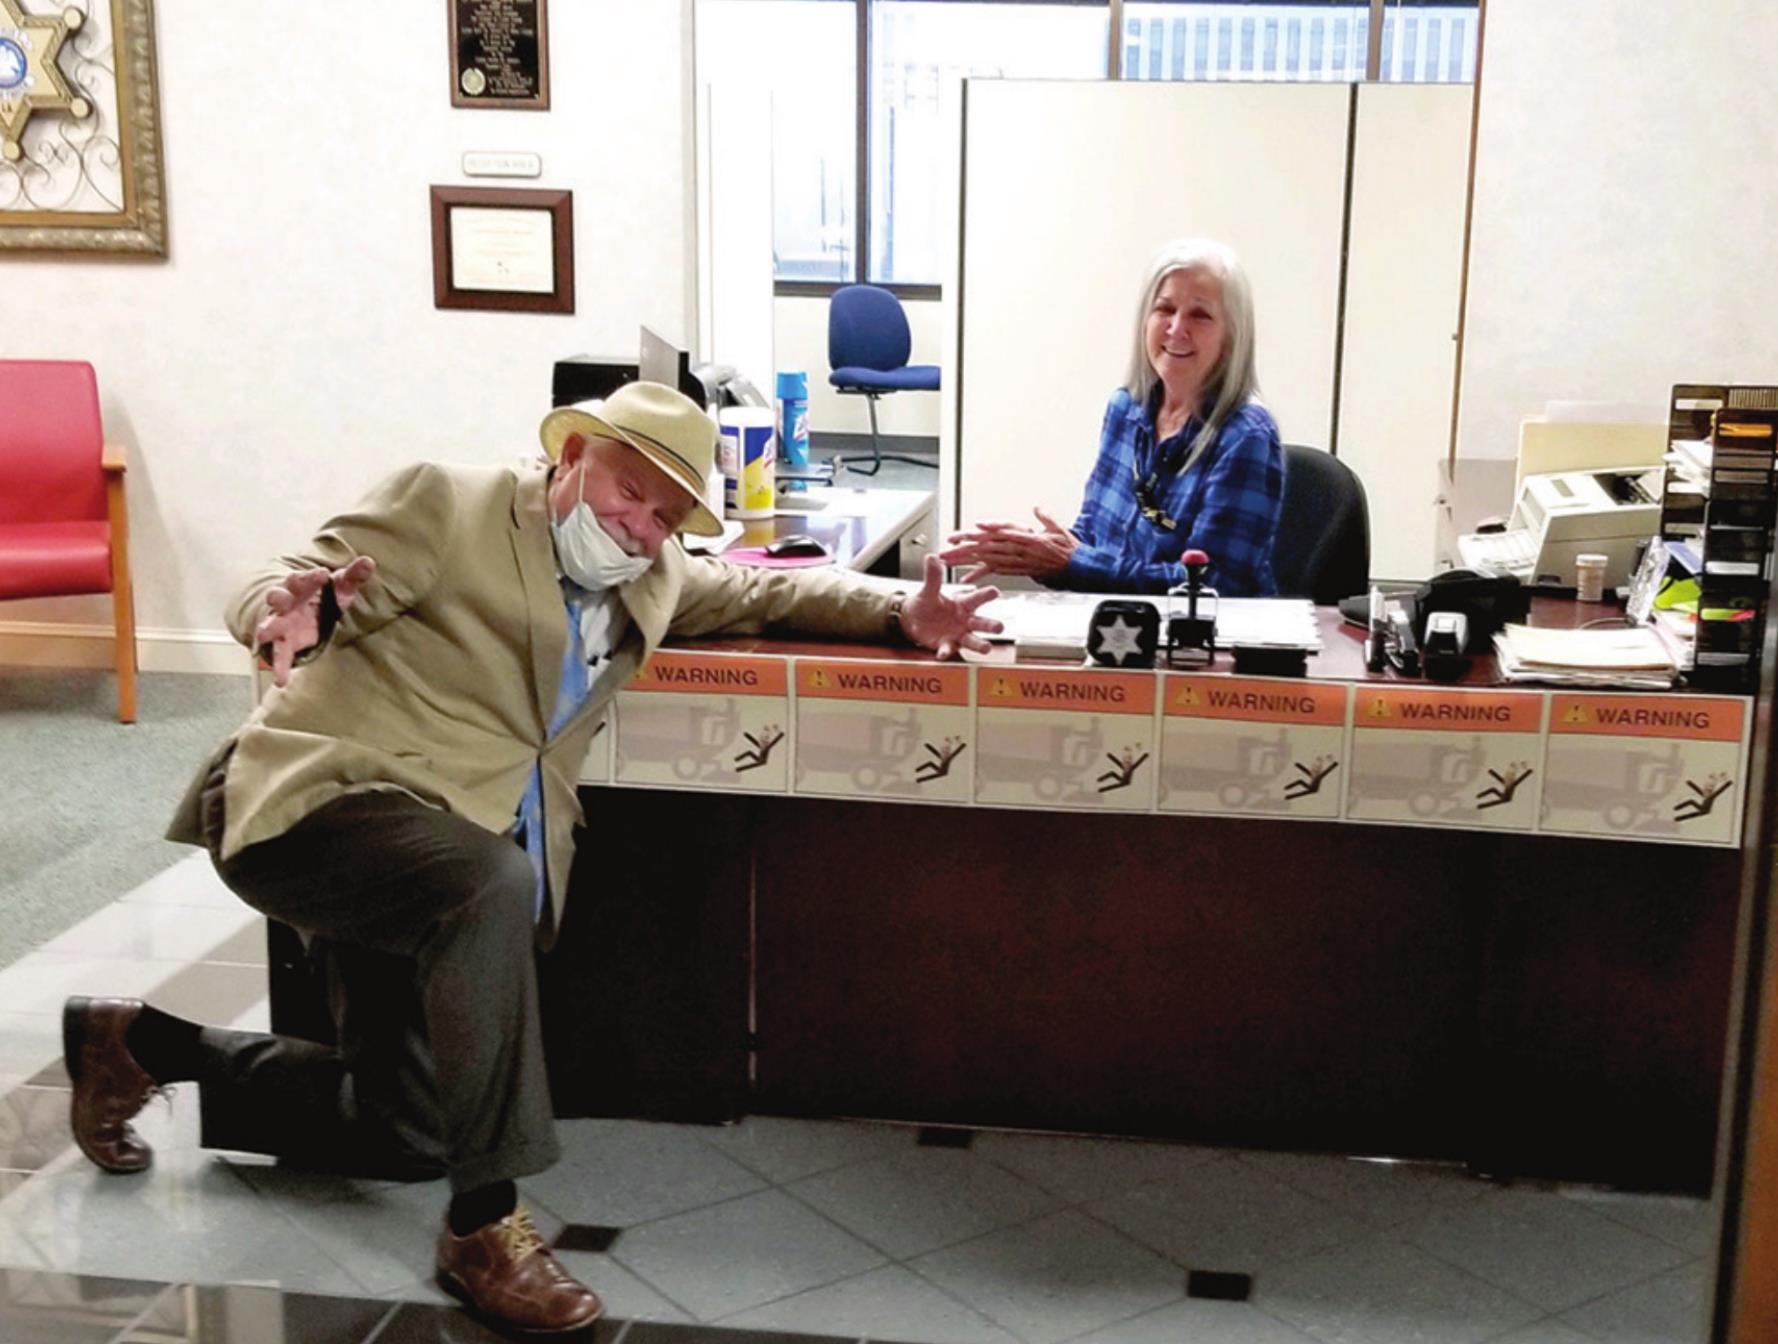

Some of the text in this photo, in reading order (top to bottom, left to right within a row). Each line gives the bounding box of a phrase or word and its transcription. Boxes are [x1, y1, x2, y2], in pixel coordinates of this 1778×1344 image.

[655, 666, 758, 686] WARNING
[838, 675, 943, 695] WARNING
[1020, 682, 1125, 703] WARNING
[1208, 690, 1314, 714] WARNING
[1400, 702, 1512, 723] WARNING
[1597, 708, 1710, 729] WARNING
